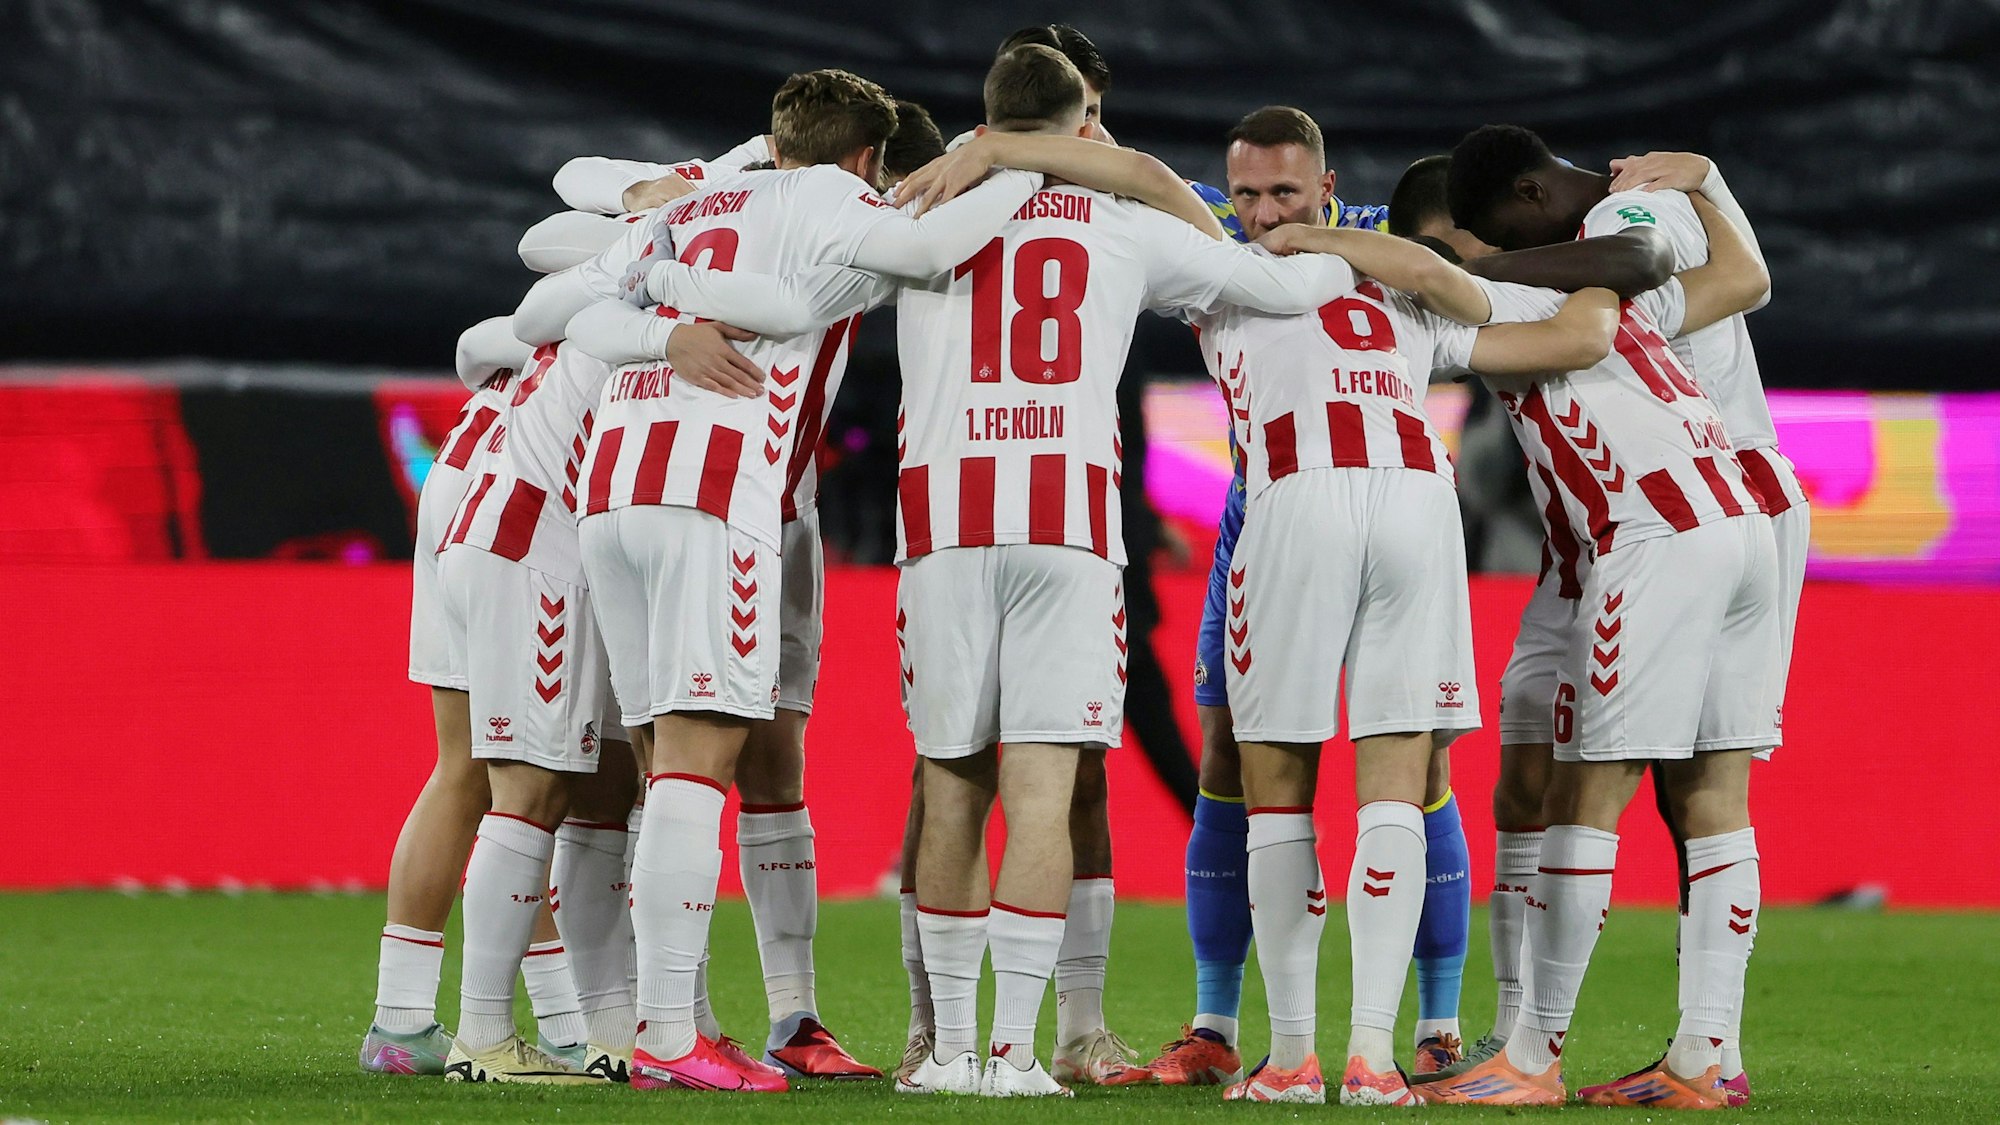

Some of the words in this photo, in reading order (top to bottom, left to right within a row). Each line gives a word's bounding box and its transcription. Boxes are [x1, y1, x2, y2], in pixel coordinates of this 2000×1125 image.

[954, 236, 1090, 385] 18
[1331, 368, 1348, 394] 1.
[1349, 370, 1373, 394] FC
[966, 408, 981, 441] 1.
[985, 407, 1008, 441] FC
[1012, 400, 1064, 439] KÖLN
[690, 689, 716, 698] hummel
[1435, 699, 1464, 708] hummel
[486, 733, 513, 742] hummel
[758, 863, 769, 871] 1.
[771, 862, 791, 871] FC
